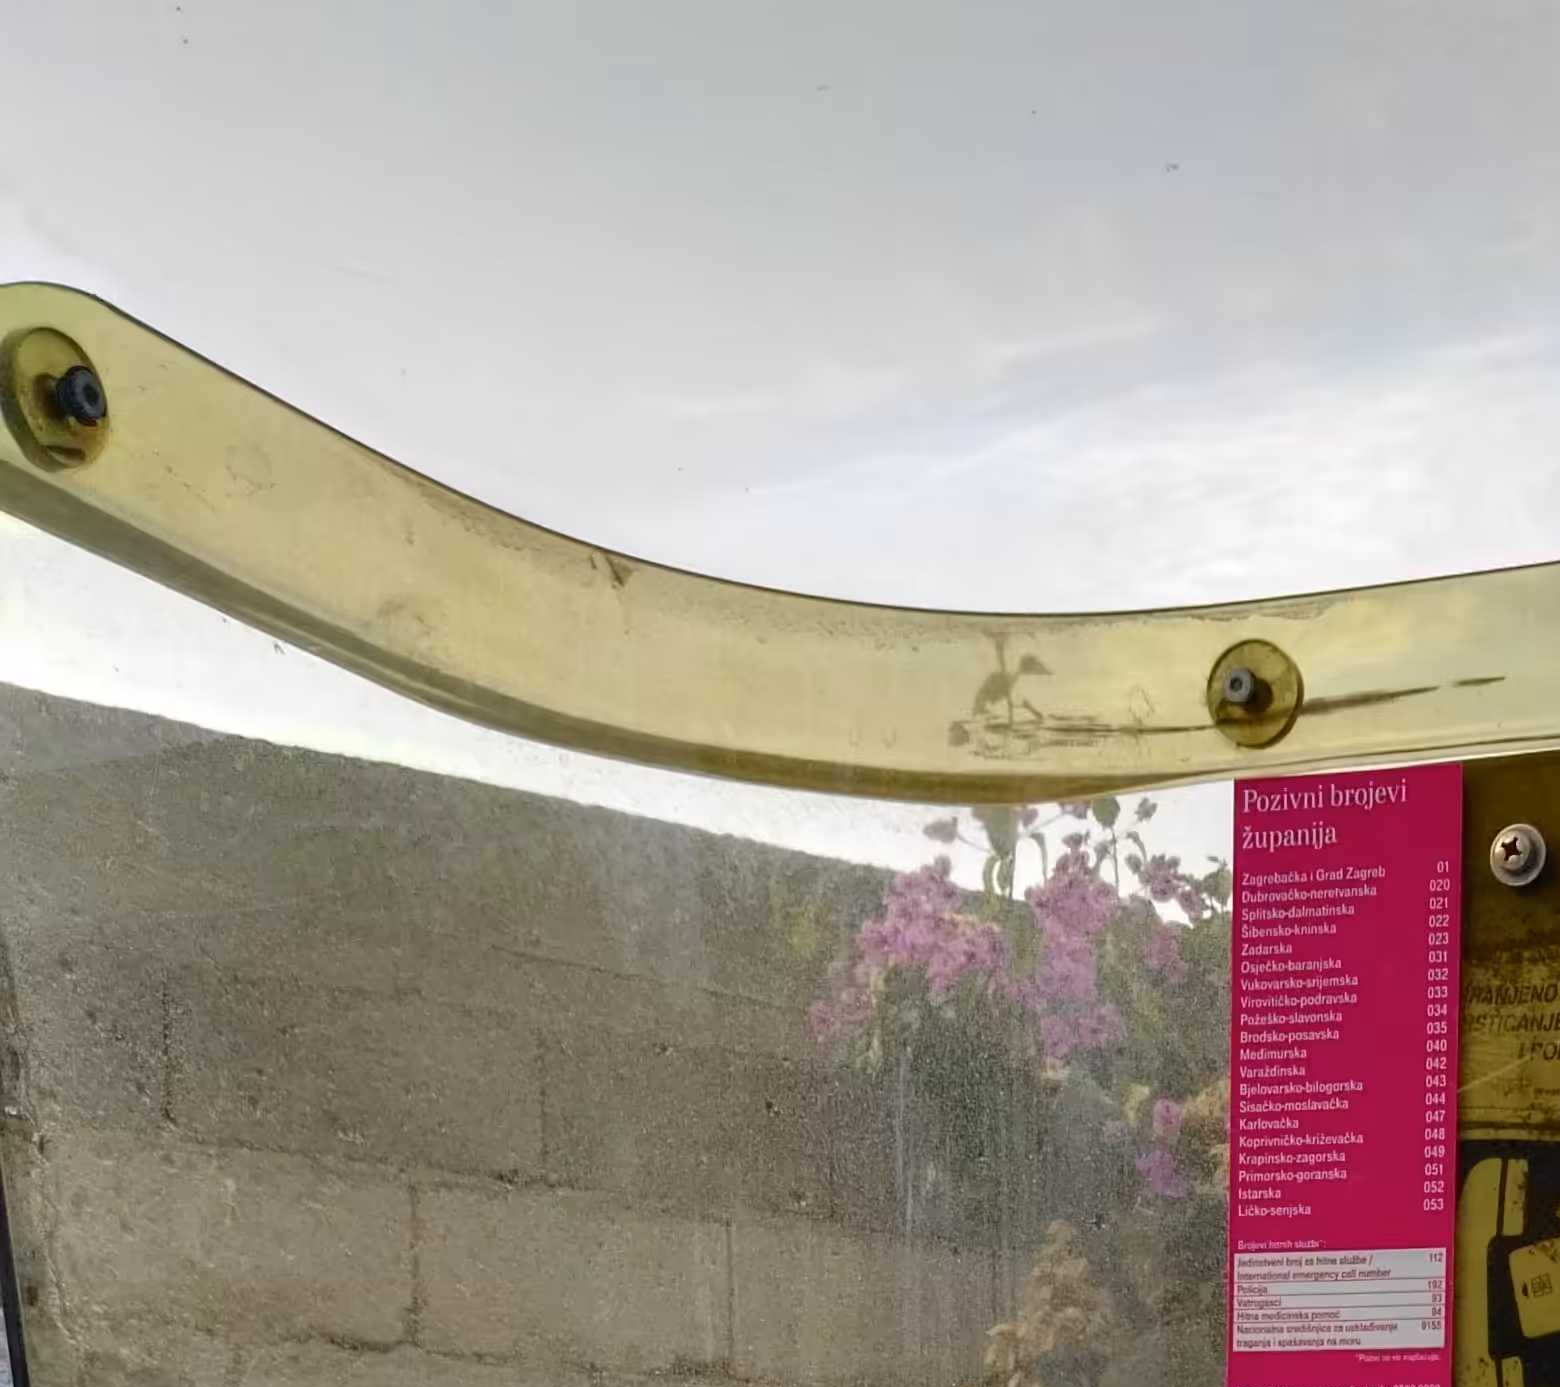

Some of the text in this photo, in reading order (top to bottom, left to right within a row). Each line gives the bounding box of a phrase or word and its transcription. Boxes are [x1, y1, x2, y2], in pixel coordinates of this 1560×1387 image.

[1244, 778, 1406, 813] Pozivni brojevi
[1242, 821, 1337, 852] županija
[1242, 871, 1307, 887] Zagrebačka
[1316, 868, 1343, 881] Grad
[1346, 865, 1386, 881] Zagreb
[1437, 861, 1449, 873] 01
[1242, 878, 1450, 903] Dubrovačko-neretvanska 020
[1242, 897, 1448, 923] Splitsko-dalmatinska 021
[1241, 914, 1449, 938] Šibensko-kninska 022
[1241, 932, 1449, 956] Zadarska 023
[1241, 950, 1447, 975] Osječko-baranjska 031
[1241, 968, 1448, 990] Vukovarsko-srijemska 032
[1241, 986, 1448, 1008] Virovitičko-podravska 033
[1240, 1004, 1447, 1026] Požeško-slavonska 034
[1240, 1021, 1447, 1044] Brodsko-posavska 035
[1240, 1039, 1447, 1060] Međimurska 040
[1240, 1057, 1447, 1078] Varaždinska 042
[1240, 1074, 1446, 1098] Bjelovarsko-bilogorska 043
[1240, 1092, 1445, 1113] Sisačko-moslavačka 044
[1239, 1110, 1446, 1130] Karlovačka 047
[1239, 1128, 1445, 1150] Koprivničko-križevačka 048
[1239, 1145, 1445, 1166] Krapinsko-zagorska 049
[1239, 1163, 1443, 1183] Primorsko-goranska 051
[1238, 1180, 1444, 1199] Istarska 052
[1238, 1198, 1444, 1218] Ličko-senjska 053
